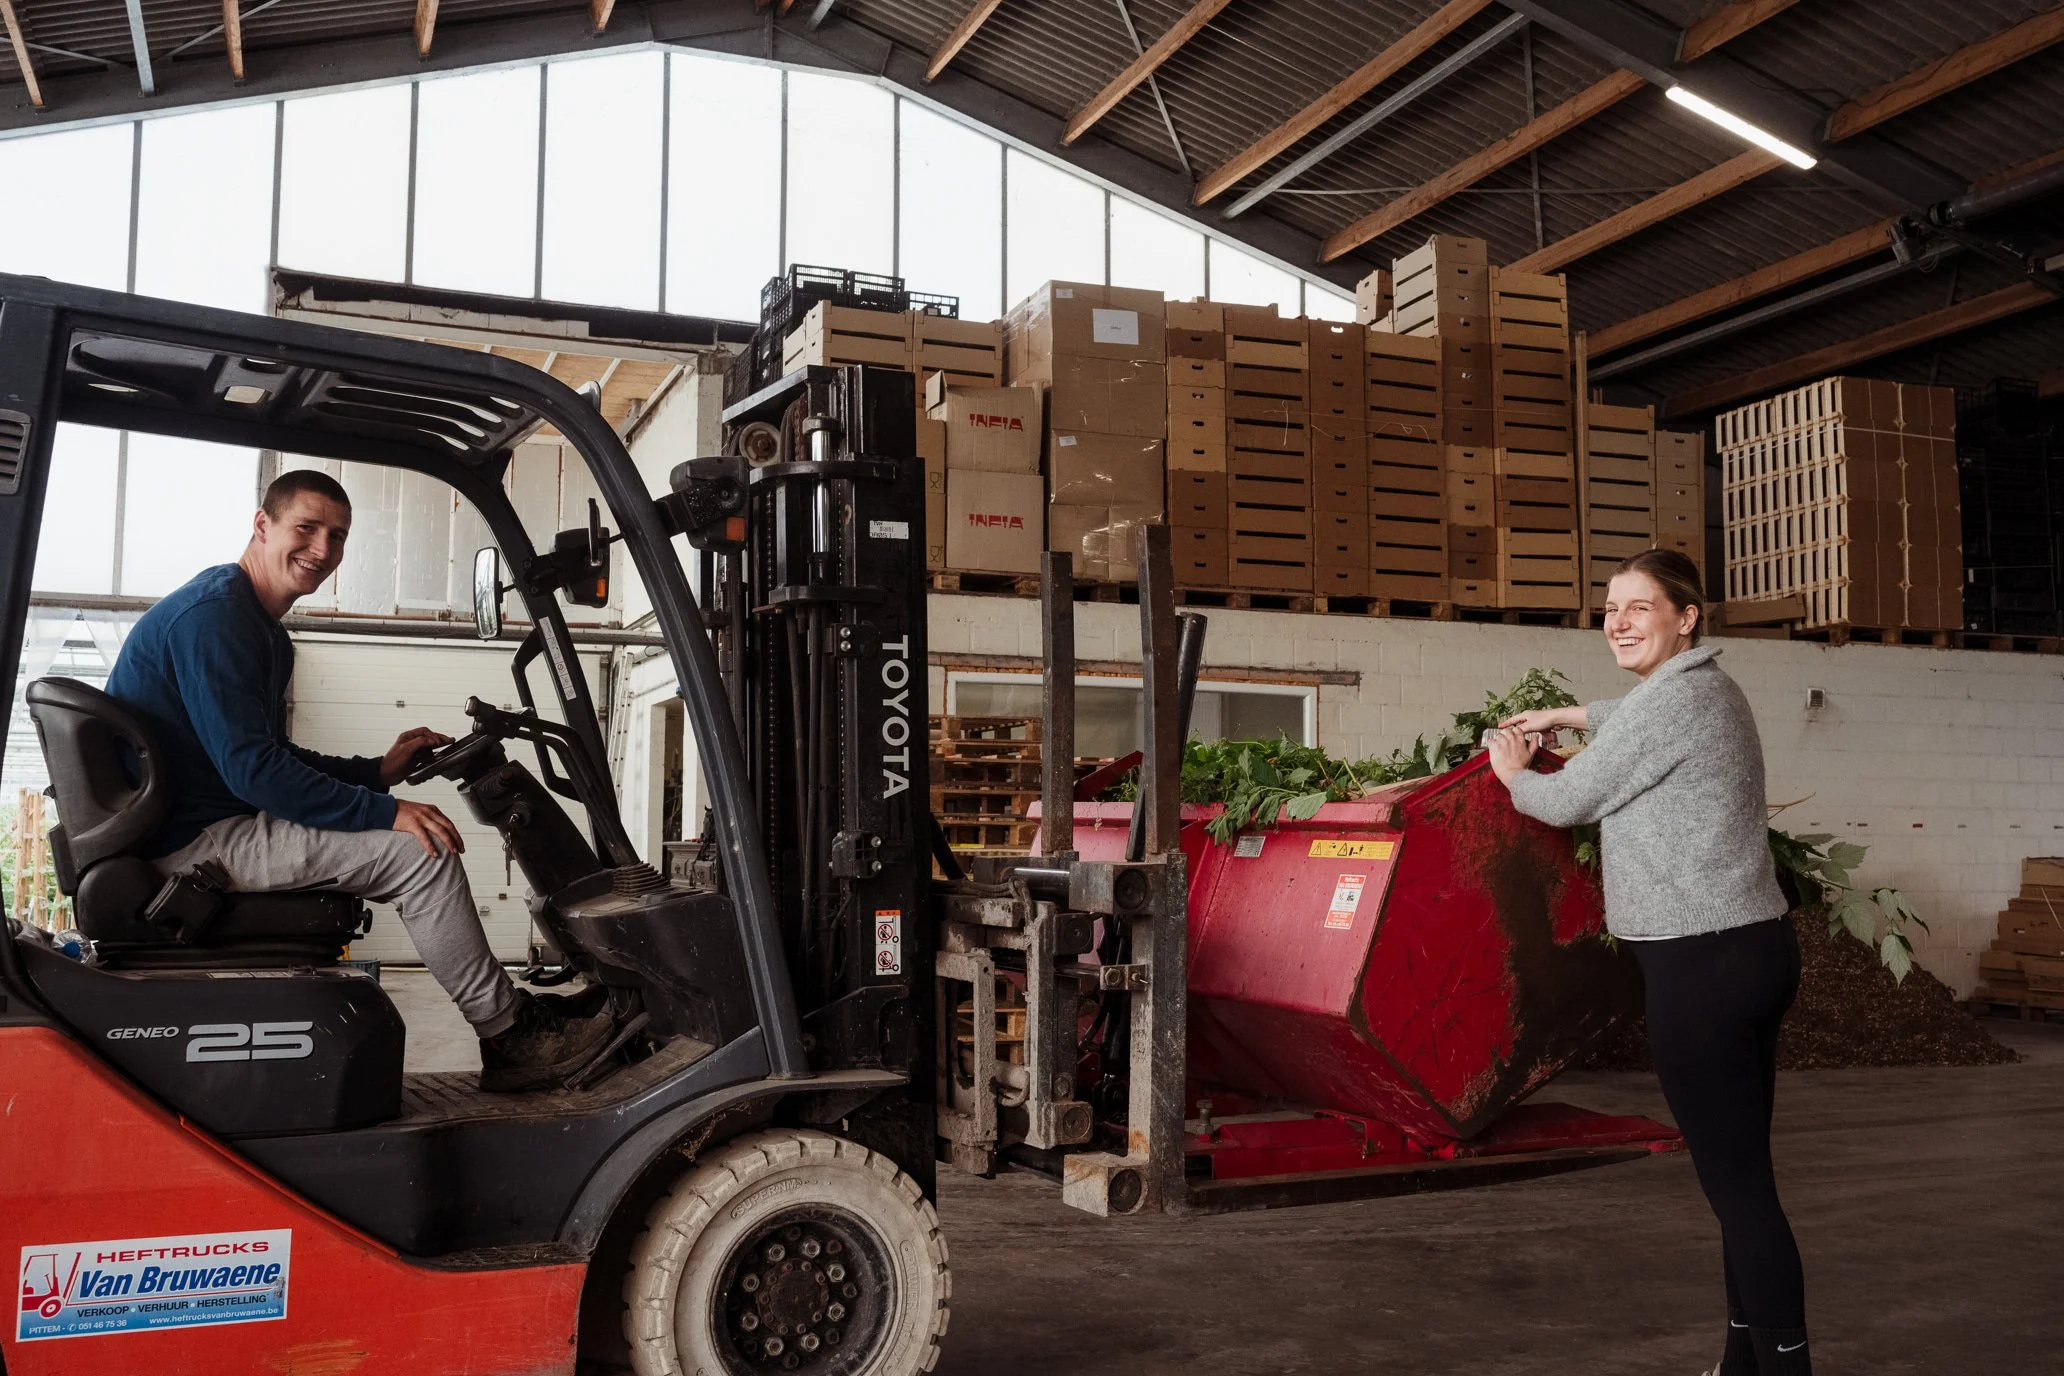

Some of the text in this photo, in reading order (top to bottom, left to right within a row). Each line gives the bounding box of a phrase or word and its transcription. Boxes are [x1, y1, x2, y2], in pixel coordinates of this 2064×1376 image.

[969, 413, 1023, 431] INFIA
[969, 513, 1024, 530] INFIA
[881, 634, 910, 799] TOYOTA
[106, 1021, 314, 1063] GENEO 25
[97, 1241, 270, 1263] HEFTRUCKS
[79, 1262, 282, 1298] Van Bruwaene
[77, 1295, 267, 1318] VERKOOP VERHUUR HERSTELLING
[149, 1308, 278, 1324] www.heftrucksvanbruwaene.be
[29, 1325, 60, 1334] PITTEM
[93, 1321, 104, 1329] 46
[105, 1320, 115, 1328] 75
